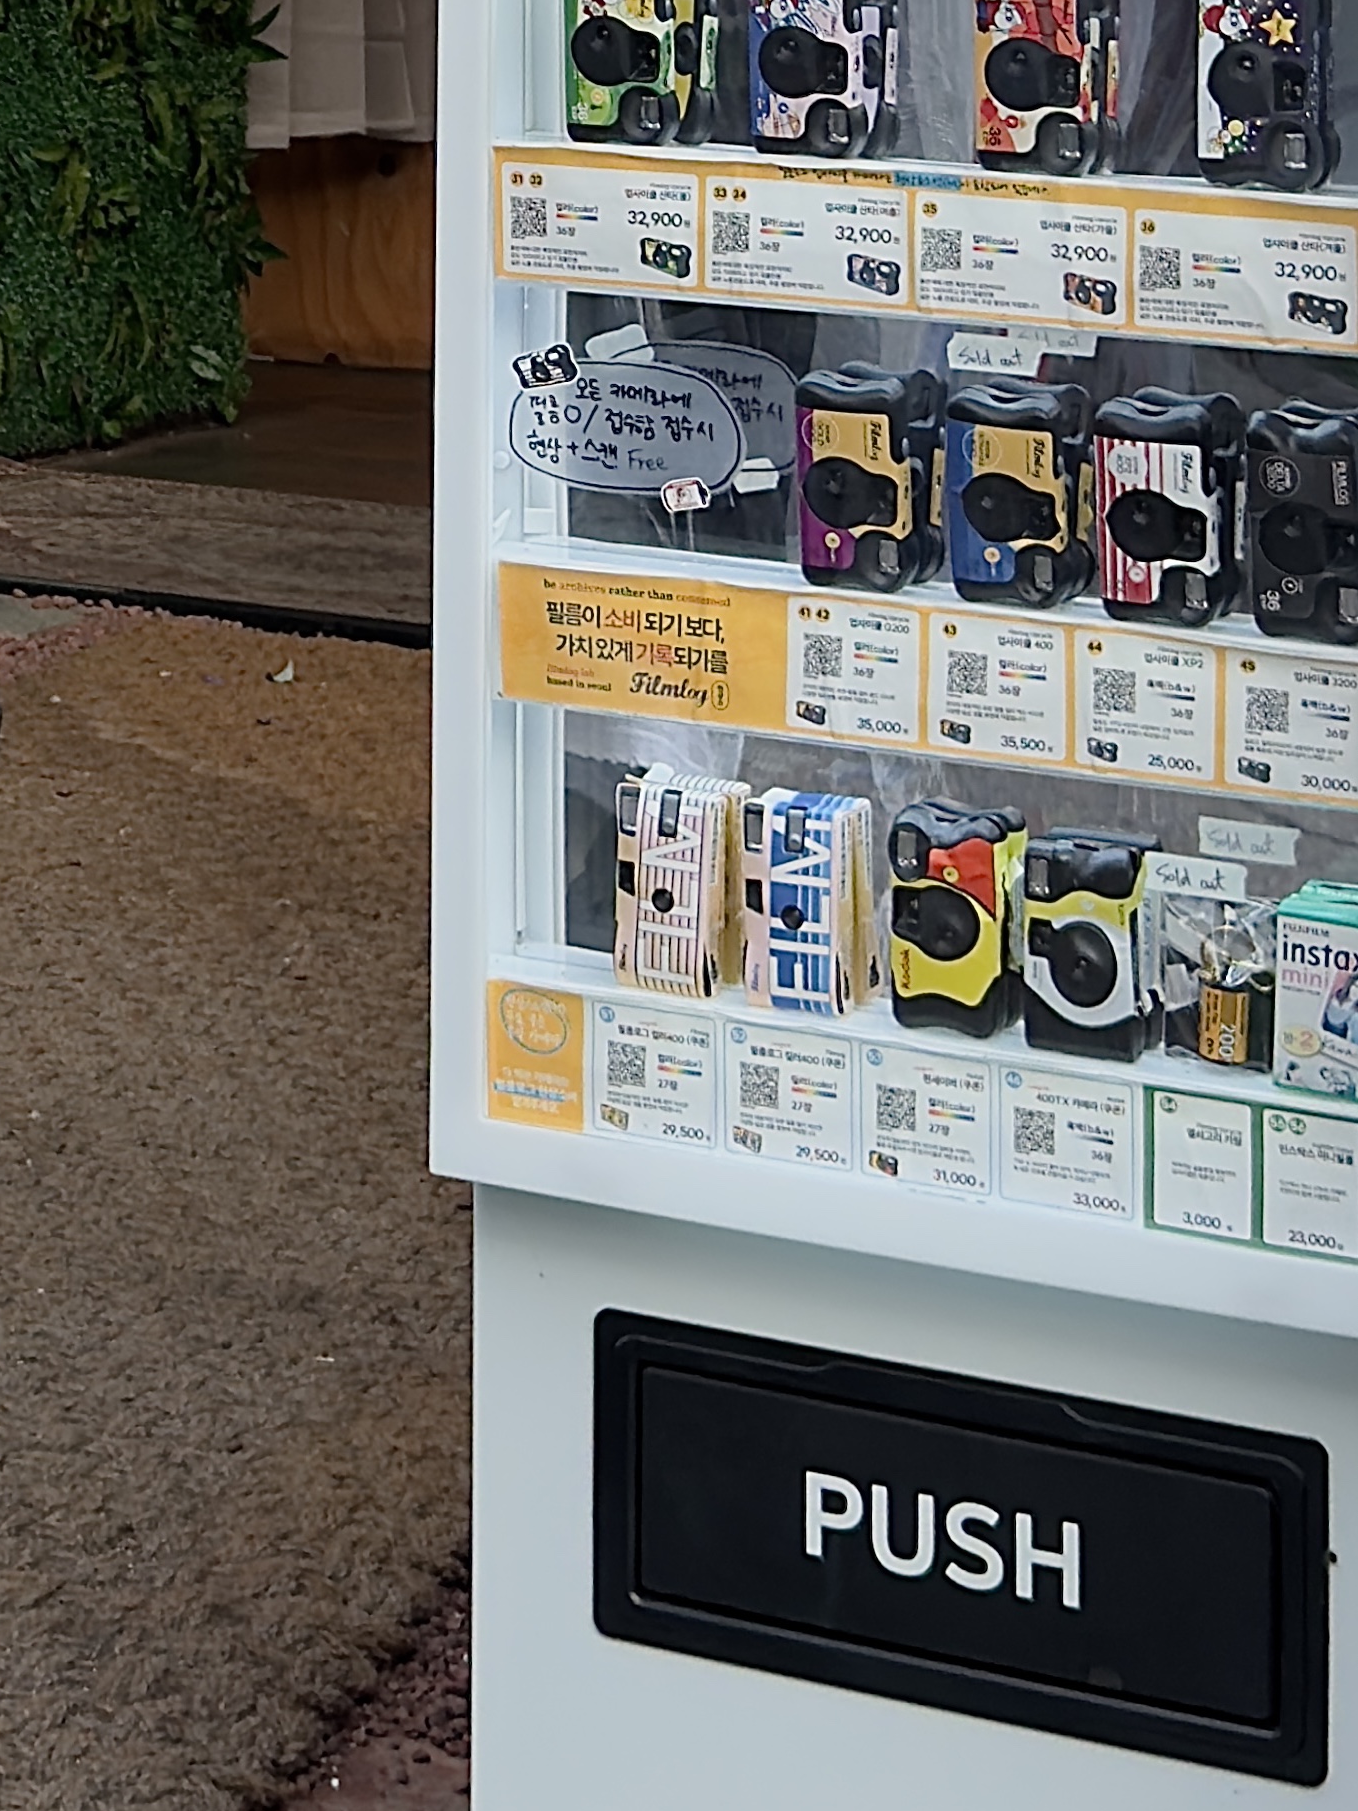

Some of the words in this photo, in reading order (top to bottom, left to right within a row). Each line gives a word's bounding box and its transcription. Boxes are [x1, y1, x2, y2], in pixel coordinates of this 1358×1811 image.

[959, 346, 993, 367] Sold
[1000, 347, 1024, 367] out
[575, 377, 603, 402] 모든
[609, 382, 692, 410] 카메라에
[526, 429, 562, 464] 현상
[581, 438, 618, 470] 스캔
[627, 447, 669, 472] Free
[543, 578, 556, 589] be
[608, 585, 645, 600] rather
[647, 589, 673, 601] than
[1268, 590, 1281, 612] 36
[546, 601, 602, 628] 필름이
[604, 608, 641, 633] 소비
[644, 611, 682, 637] 되기
[685, 615, 725, 644] 보다,
[556, 633, 593, 659] 가치
[596, 637, 633, 663] 있게
[1034, 640, 1054, 651] 400
[1181, 656, 1204, 669] XP2
[546, 676, 574, 688] based
[576, 678, 585, 688] in
[587, 681, 612, 692] seoul
[629, 672, 709, 707] Filmlog
[1331, 677, 1358, 689] 3200
[1156, 864, 1189, 887] Sold
[1200, 868, 1226, 892] out
[769, 814, 832, 1002] FILM
[1283, 921, 1330, 938] FUJIFILM
[901, 948, 911, 990] Kodak
[1281, 967, 1329, 988] mini
[1218, 1022, 1236, 1061] 200
[1037, 1092, 1070, 1106] 400TX
[803, 1468, 1083, 1612] PUSH
